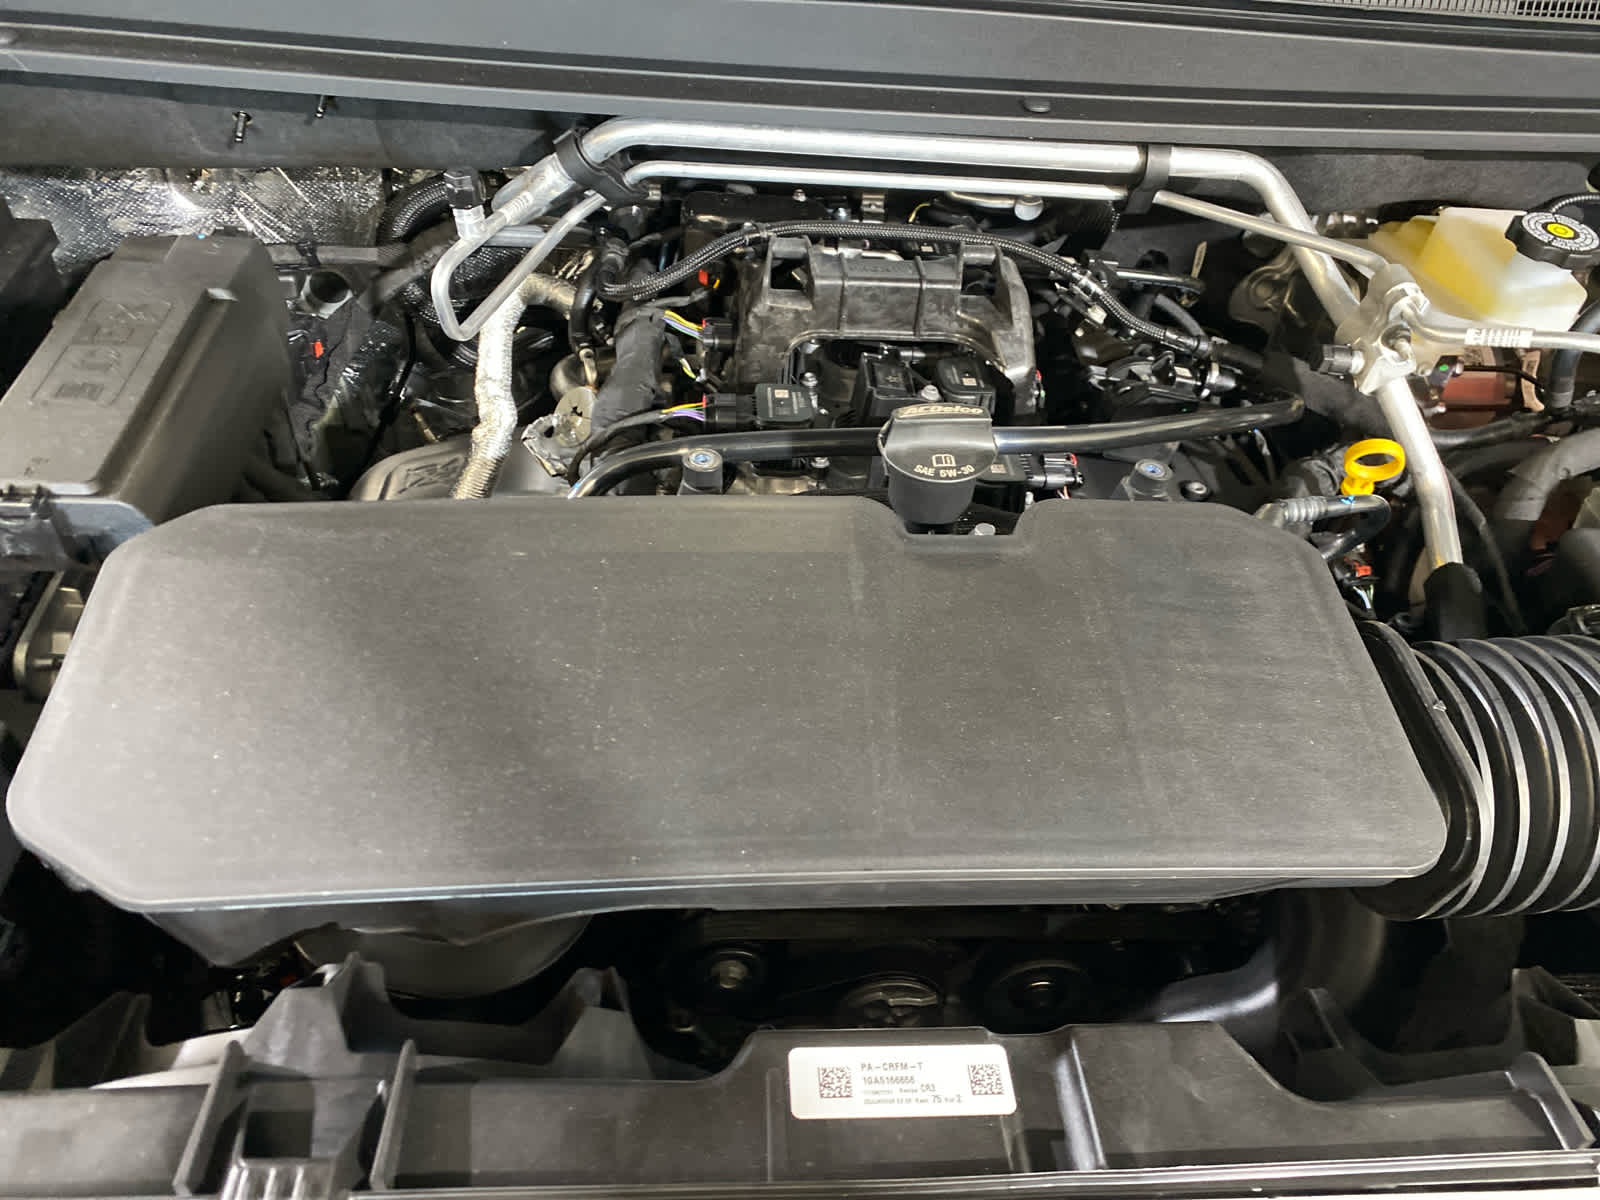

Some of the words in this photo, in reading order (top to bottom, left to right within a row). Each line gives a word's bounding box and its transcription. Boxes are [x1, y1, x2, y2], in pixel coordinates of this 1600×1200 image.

[902, 405, 984, 416] ACDelco
[913, 464, 936, 476] SAE
[939, 464, 975, 478] 5W-30
